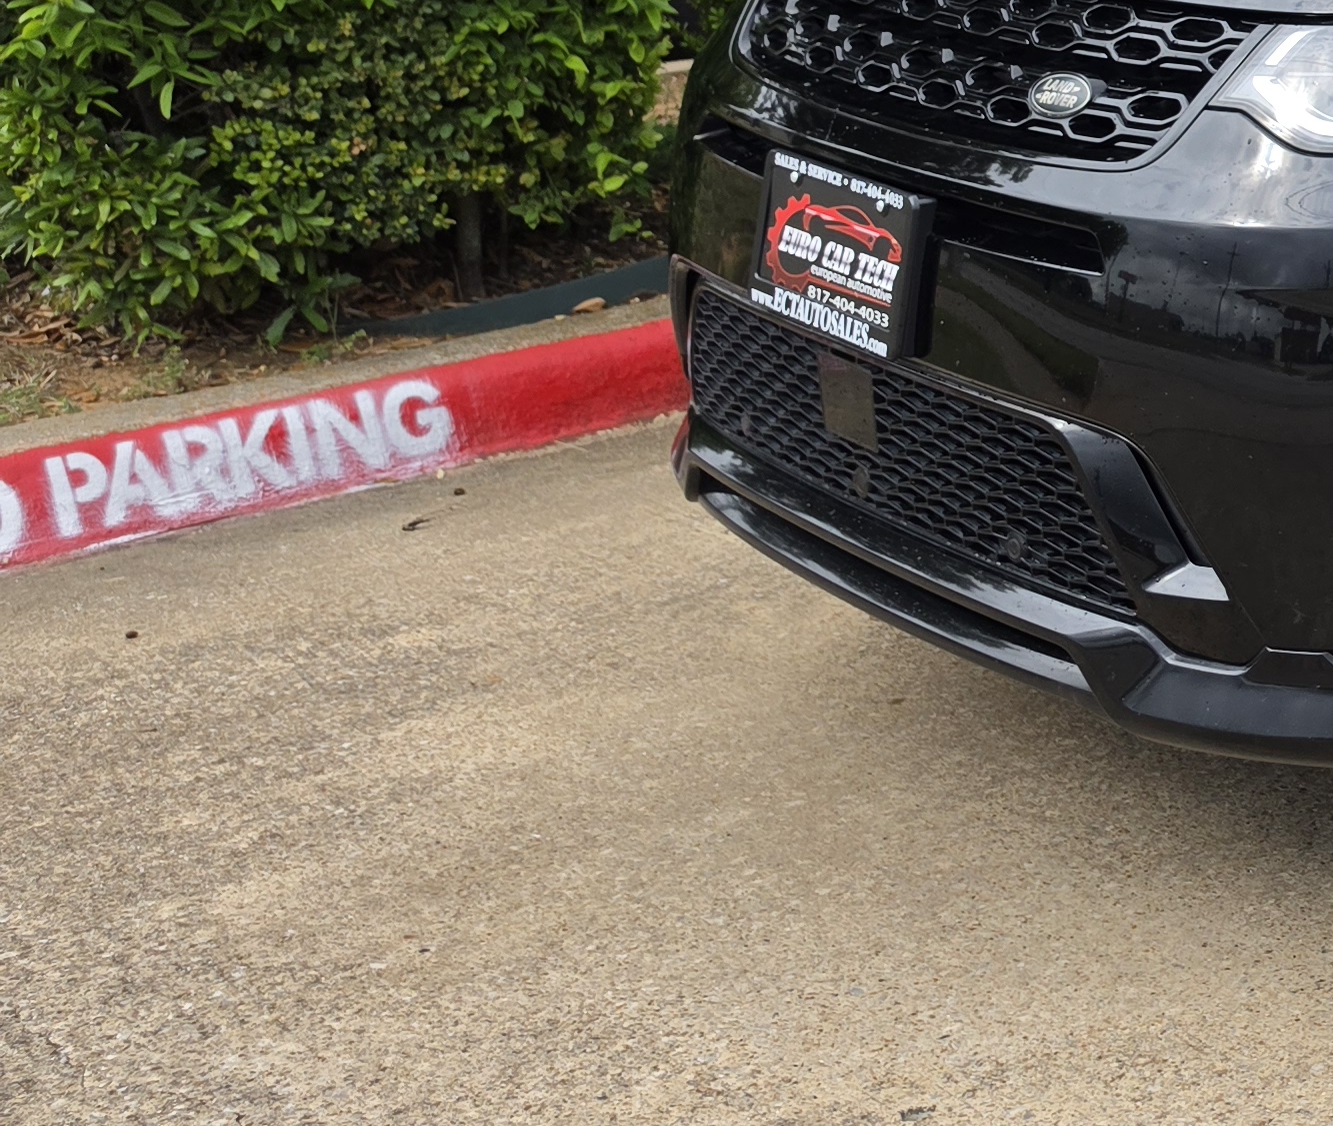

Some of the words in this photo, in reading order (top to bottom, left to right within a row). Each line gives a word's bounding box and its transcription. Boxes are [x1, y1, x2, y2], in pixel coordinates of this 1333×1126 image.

[1040, 90, 1078, 109] ROVER
[1043, 78, 1076, 94] LAND
[774, 152, 799, 171] SALES
[799, 160, 807, 175] &
[808, 163, 843, 187] SERVICE
[778, 224, 822, 263] EURO
[821, 241, 855, 275] CAR
[854, 252, 900, 292] TECH
[810, 264, 847, 287] european
[846, 276, 893, 304] automotive
[750, 286, 888, 358] www.ECTAUTOSALES.com
[807, 284, 890, 328] 817-404-4033
[44, 379, 456, 539] PARKING
